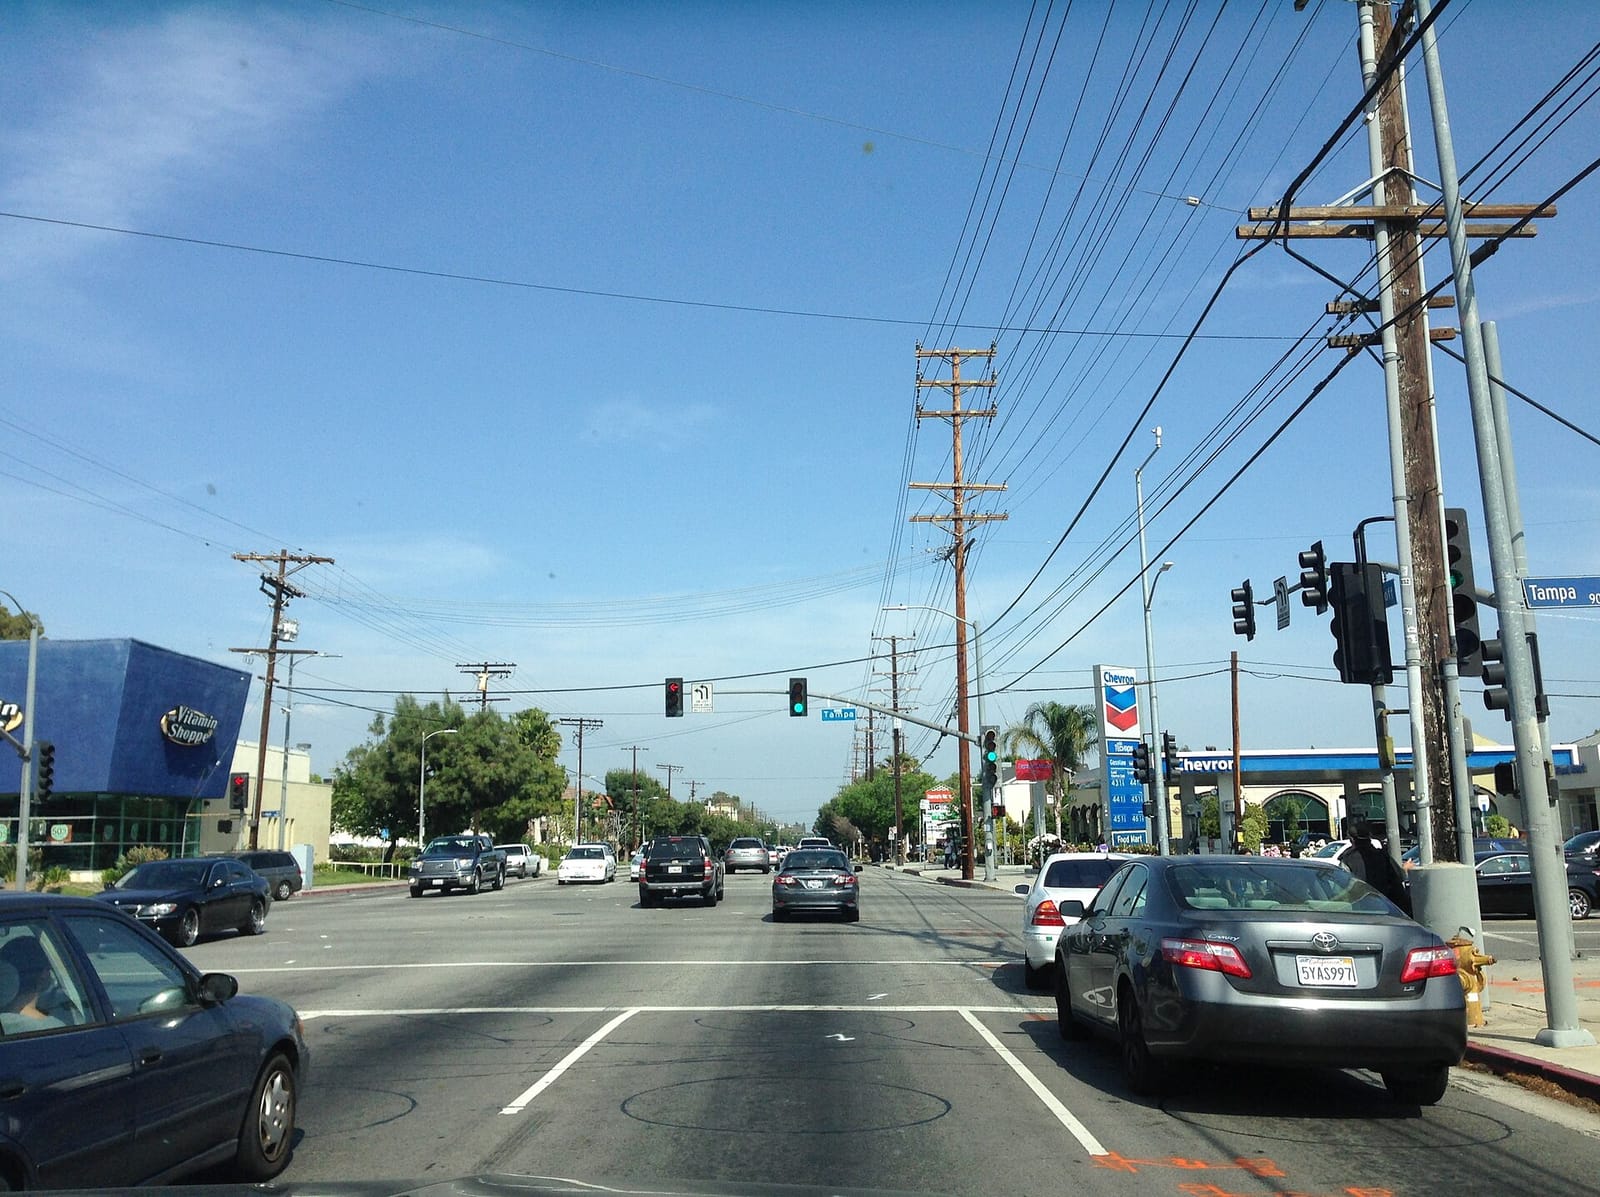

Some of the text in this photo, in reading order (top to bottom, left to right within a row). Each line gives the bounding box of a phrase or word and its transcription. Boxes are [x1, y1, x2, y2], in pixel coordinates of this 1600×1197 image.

[1528, 584, 1576, 603] Tampa
[1104, 671, 1135, 685] Chevron
[177, 705, 218, 729] Vitamin
[824, 711, 854, 719] Tampa
[168, 723, 209, 744] Shoppe
[1117, 834, 1130, 844] Food
[1301, 966, 1352, 982] 5YAS997
